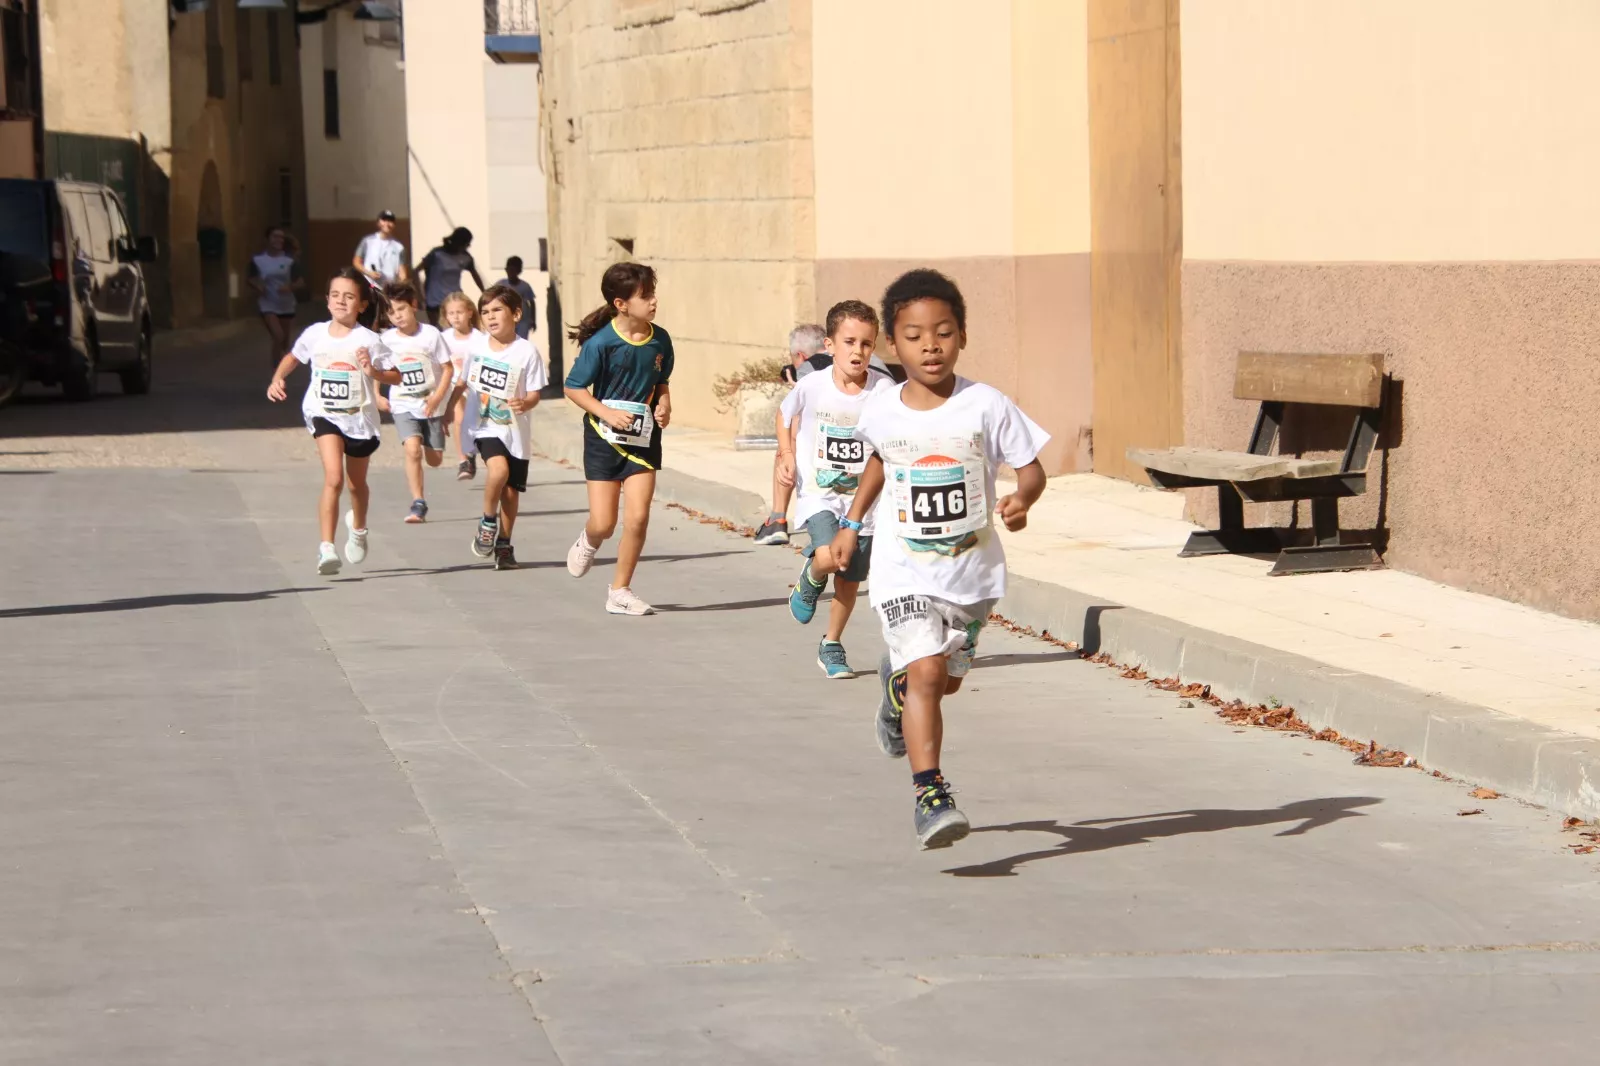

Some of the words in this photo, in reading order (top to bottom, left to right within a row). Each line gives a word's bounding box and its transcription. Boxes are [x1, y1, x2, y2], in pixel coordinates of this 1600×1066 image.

[403, 371, 424, 385] 419
[481, 368, 506, 388] 425
[321, 382, 348, 397] 430
[828, 441, 862, 459] 433
[914, 489, 965, 517] 416
[903, 600, 927, 615] ALL!
